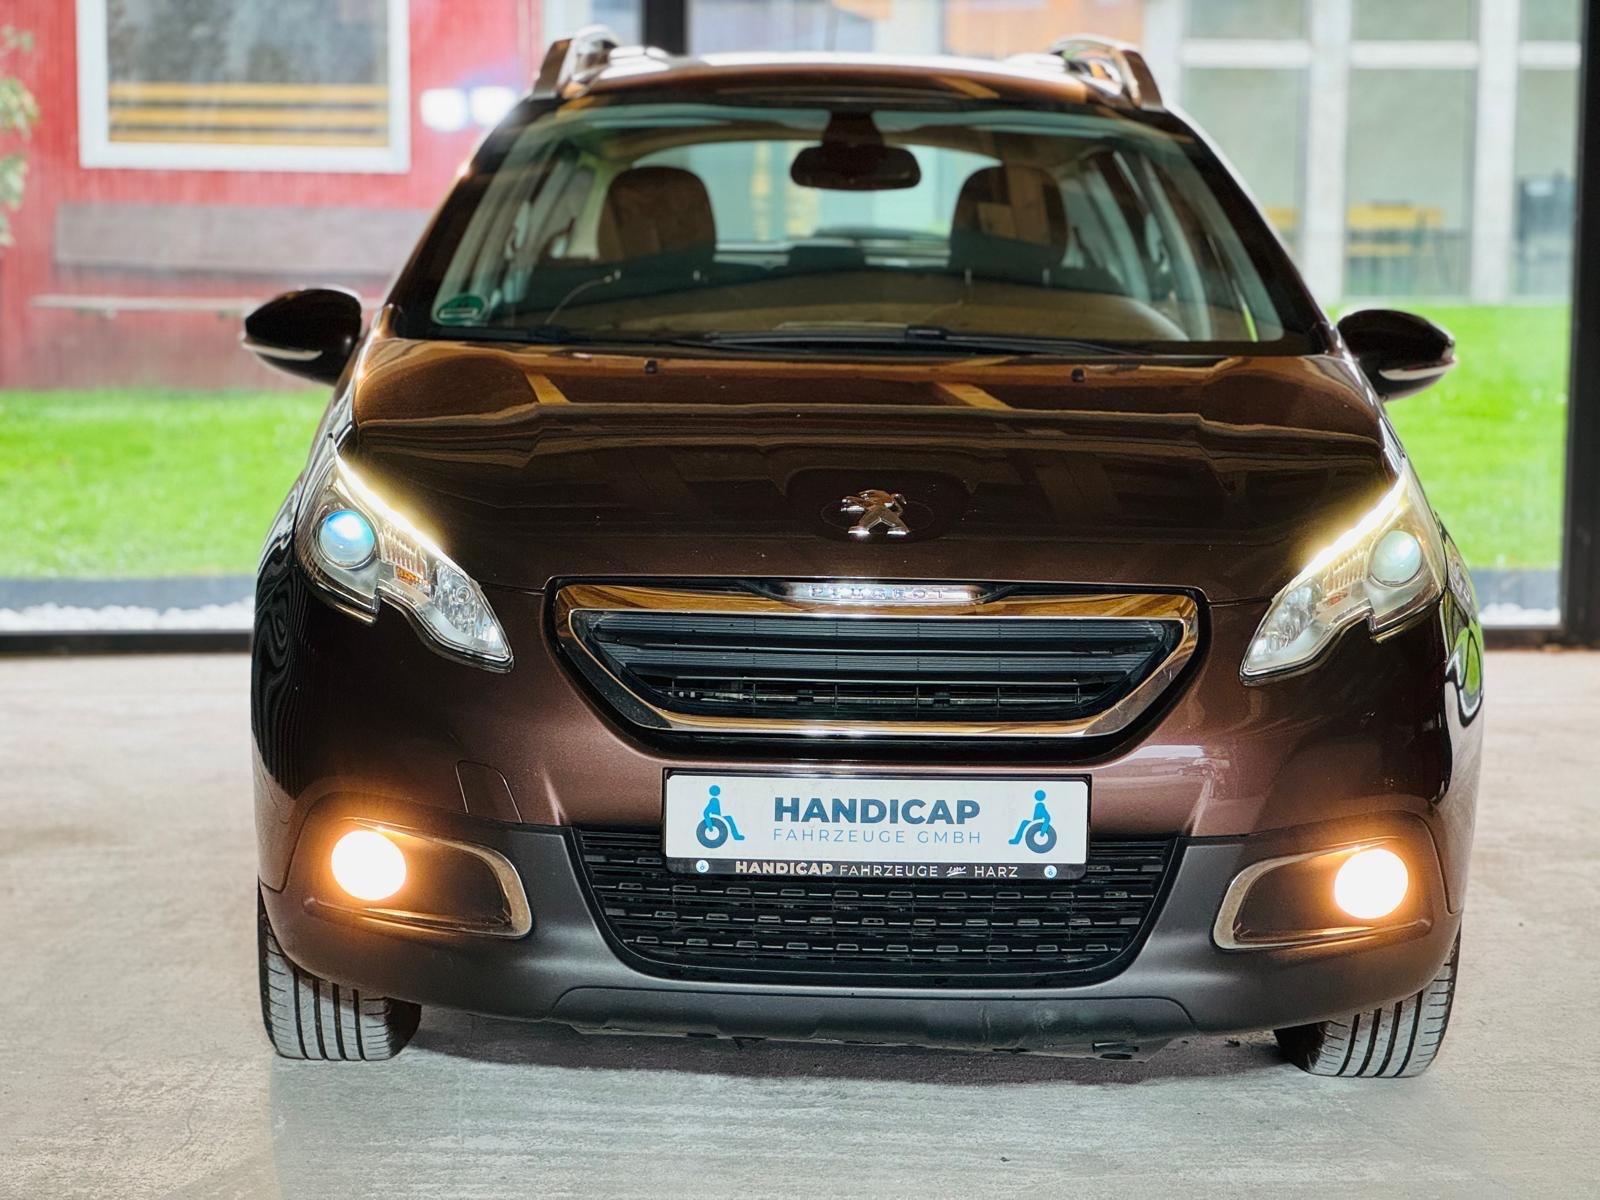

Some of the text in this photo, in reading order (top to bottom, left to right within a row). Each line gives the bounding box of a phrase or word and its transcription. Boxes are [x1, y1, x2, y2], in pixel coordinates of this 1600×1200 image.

[774, 797, 981, 825] HANDICAP
[773, 828, 981, 844] FAHRZEUGE GMBH
[735, 861, 833, 876] HANDICAP
[839, 864, 938, 877] FAHRZEUGE
[974, 866, 1019, 878] HARZ
